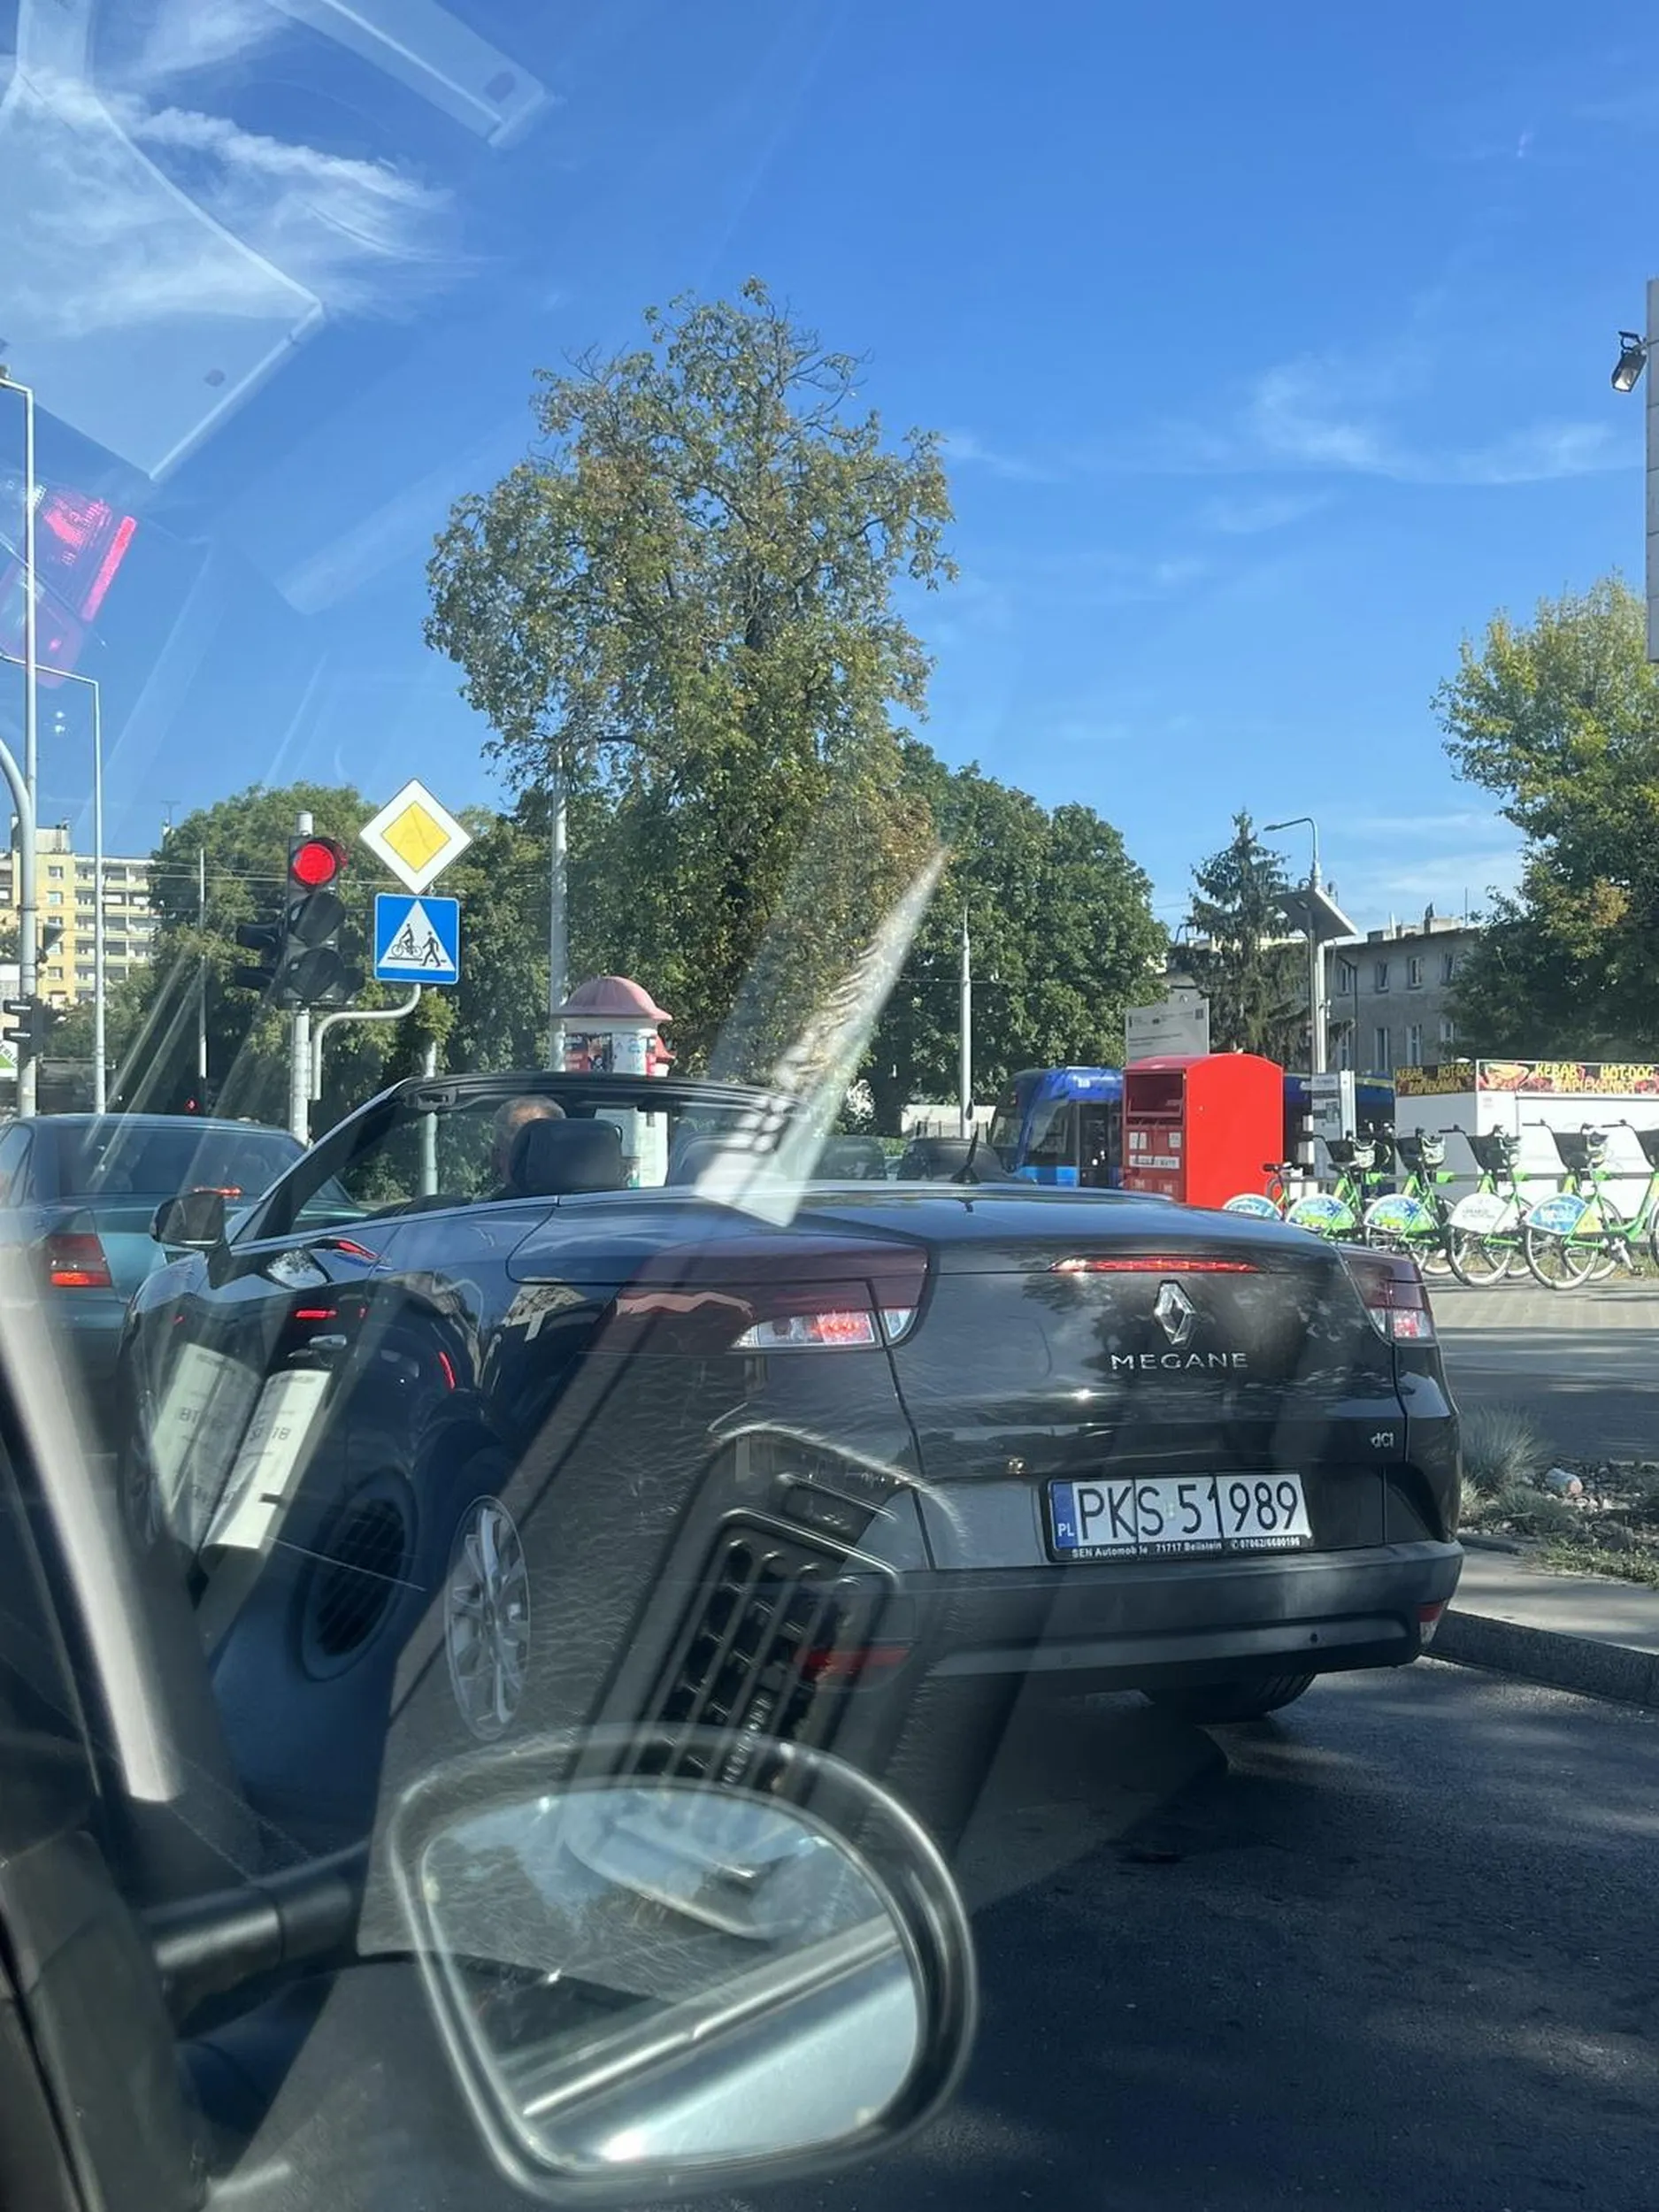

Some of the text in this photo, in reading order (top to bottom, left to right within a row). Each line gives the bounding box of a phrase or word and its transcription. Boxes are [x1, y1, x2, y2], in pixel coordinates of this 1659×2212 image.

[1535, 1063, 1655, 1080] KEBAB HOT-DOG
[1110, 1353, 1248, 1370] MEGANE
[1078, 1480, 1298, 1540] PKS 51989
[1057, 1523, 1074, 1537] PL
[1095, 1546, 1148, 1557] Automoble
